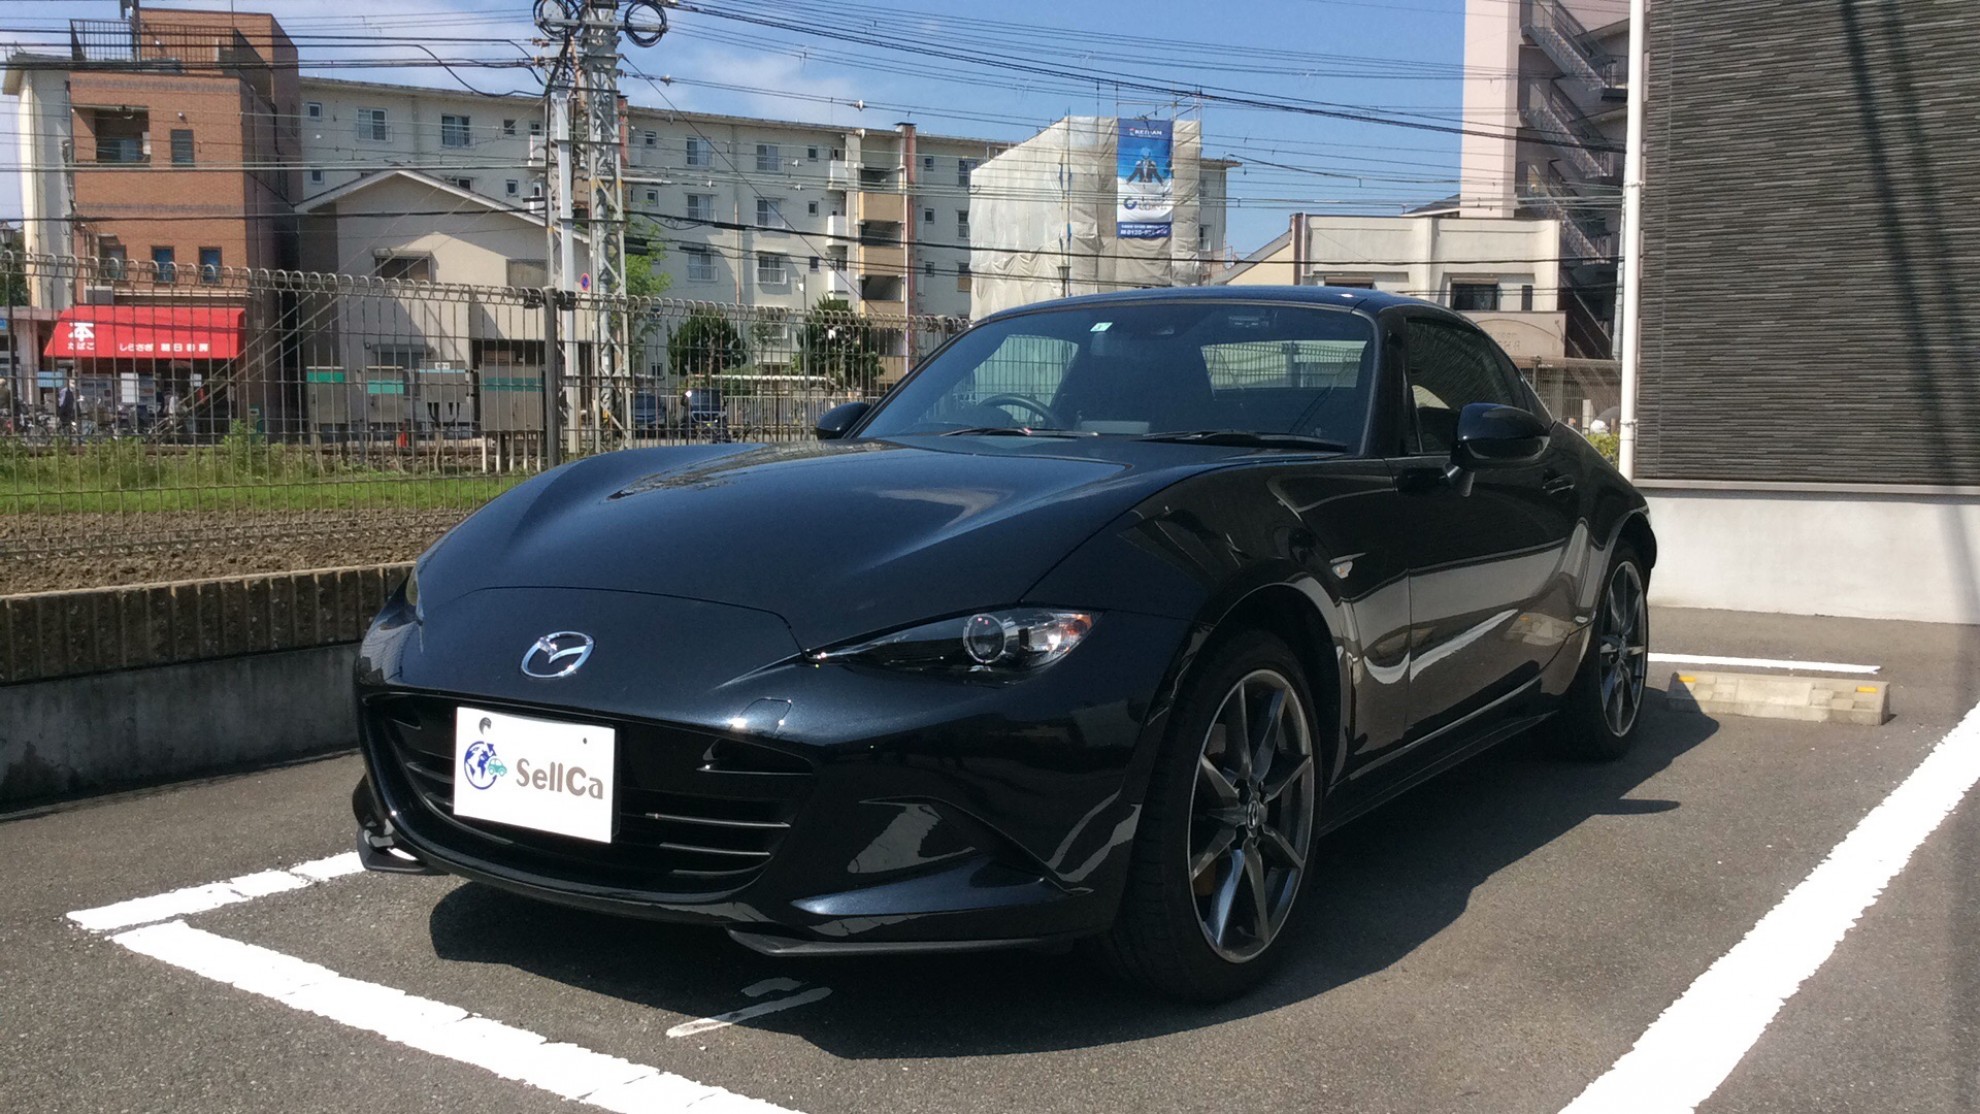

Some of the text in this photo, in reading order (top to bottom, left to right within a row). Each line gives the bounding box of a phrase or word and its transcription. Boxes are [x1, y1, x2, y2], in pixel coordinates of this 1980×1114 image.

[67, 322, 95, 342] 本
[67, 342, 95, 351] たばこ
[516, 758, 603, 800] SellCa
